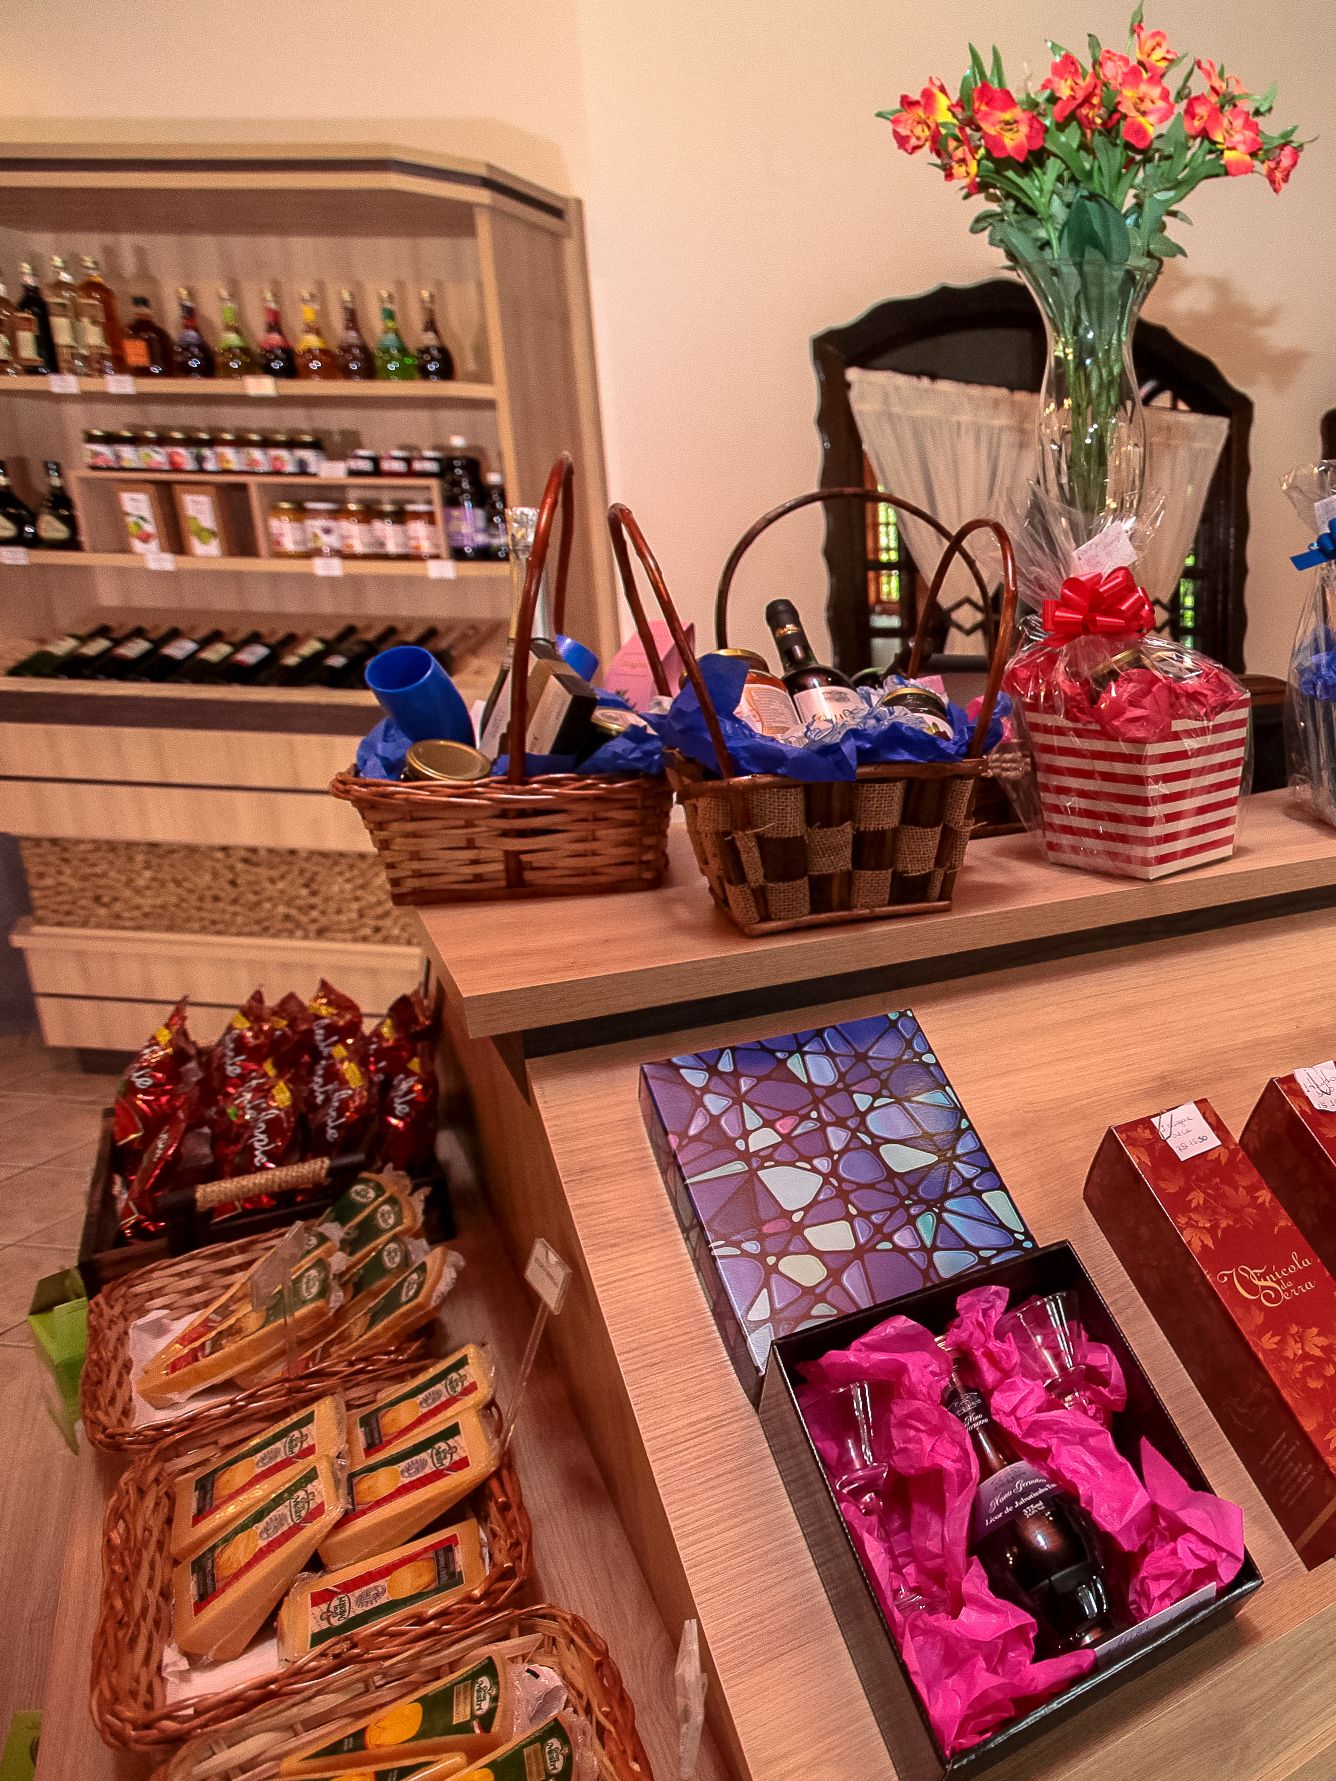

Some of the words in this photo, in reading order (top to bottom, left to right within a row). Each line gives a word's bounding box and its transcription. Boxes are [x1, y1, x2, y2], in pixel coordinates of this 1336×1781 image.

[1217, 1251, 1313, 1300] Vinícola
[1251, 1267, 1316, 1307] Serra
[1280, 1279, 1294, 1290] da
[985, 1512, 1003, 1526] Licor
[1004, 1506, 1014, 1514] de
